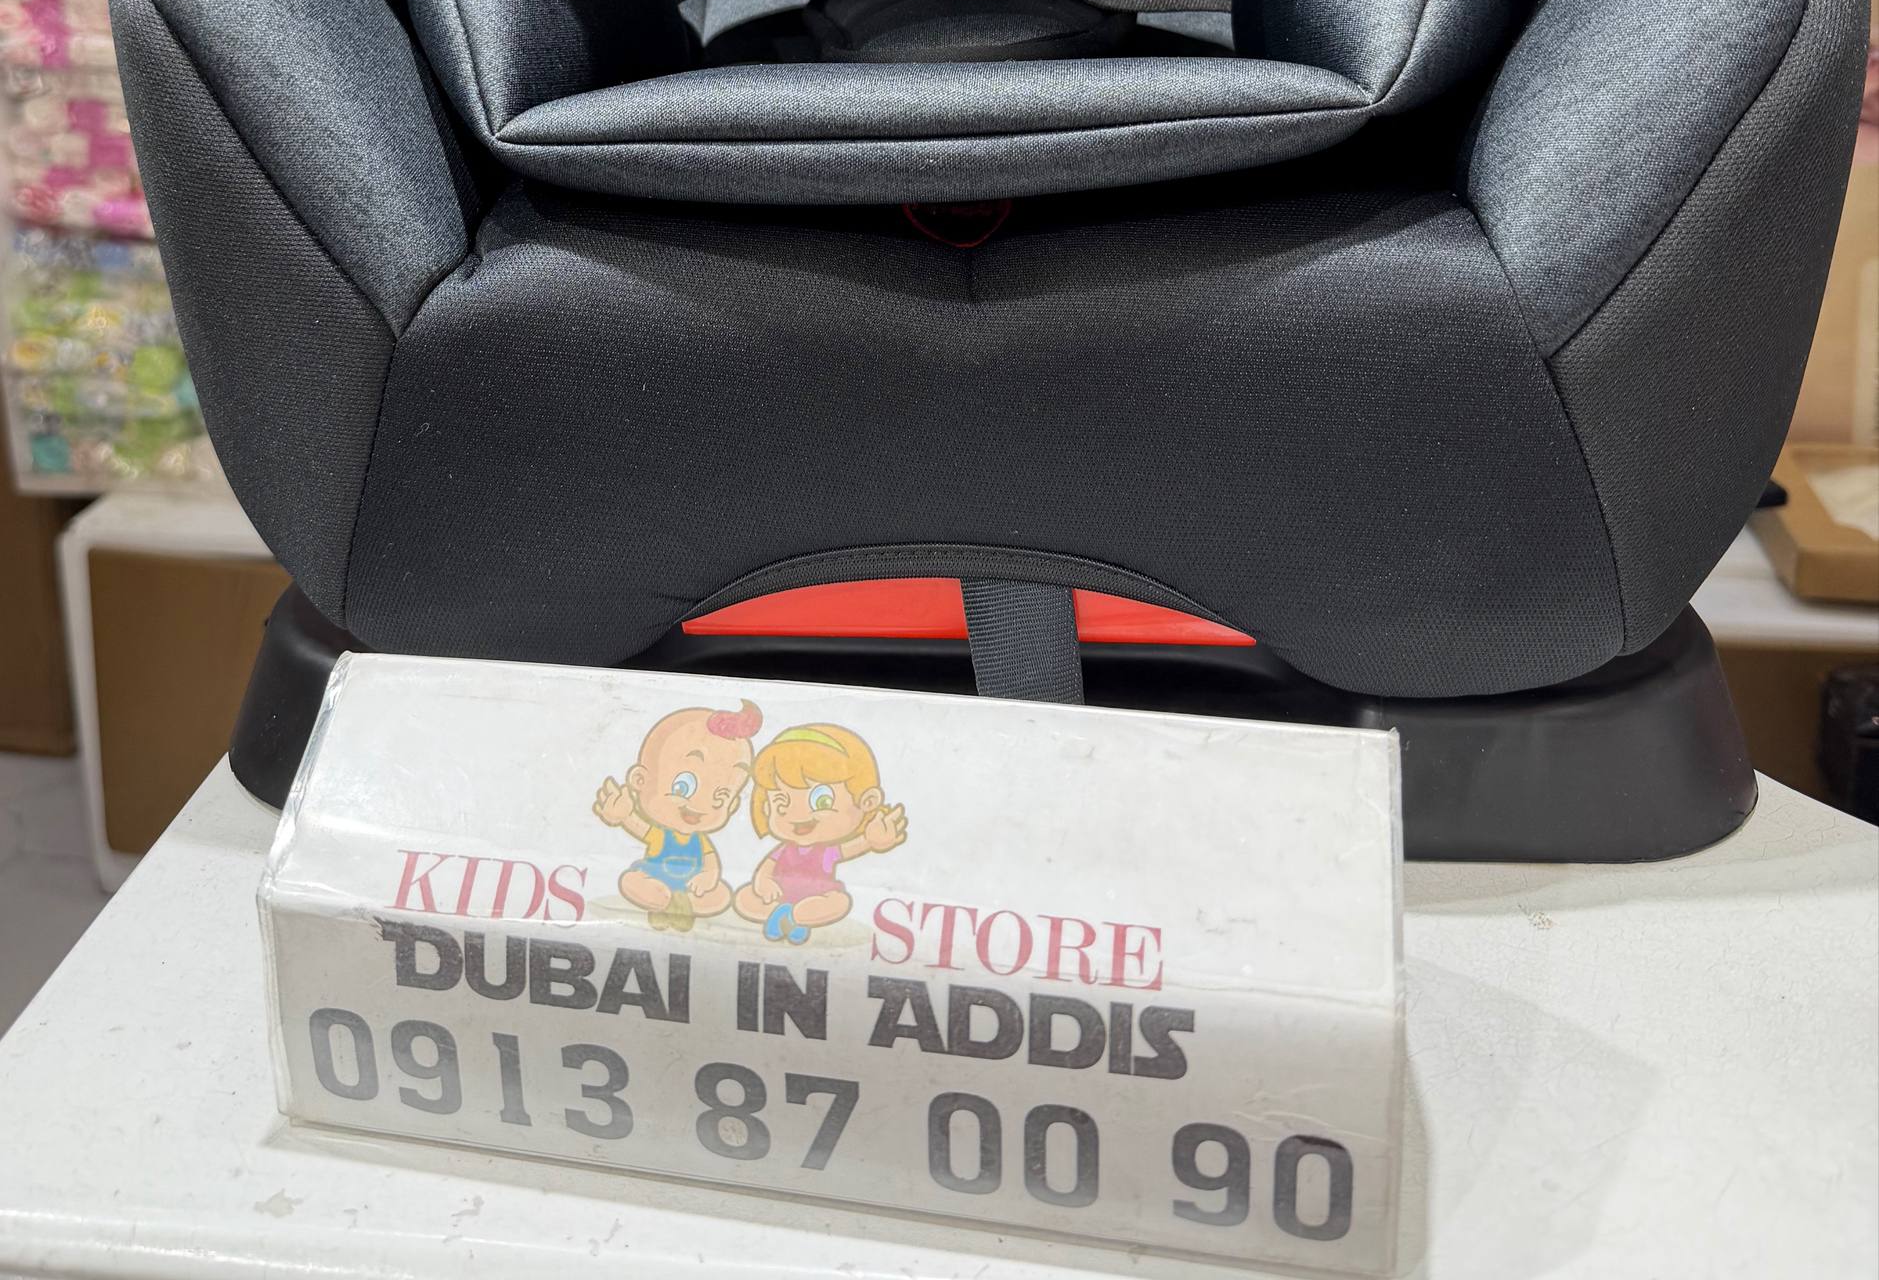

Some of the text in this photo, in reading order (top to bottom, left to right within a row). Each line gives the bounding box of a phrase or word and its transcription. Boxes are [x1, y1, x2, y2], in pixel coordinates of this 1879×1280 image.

[374, 917, 1195, 1080] DUBAI IN ADDIS
[385, 849, 1163, 991] KIDS STORE
[309, 1007, 1354, 1241] 0913 87 00 90
